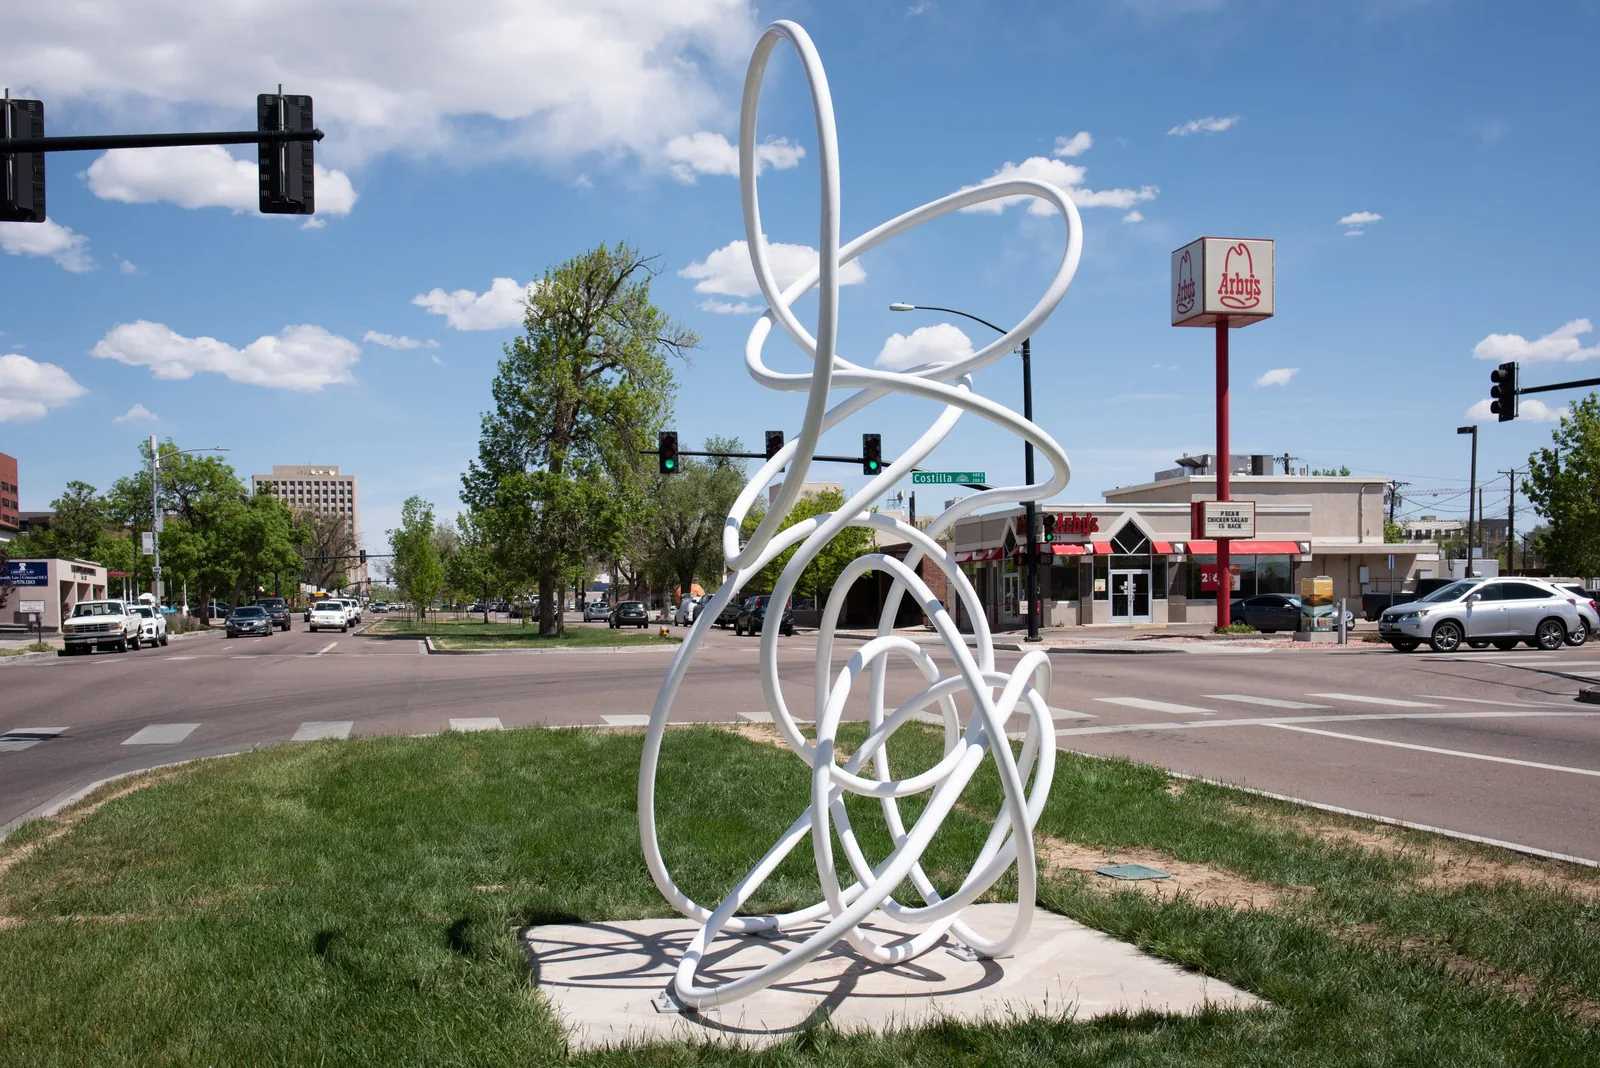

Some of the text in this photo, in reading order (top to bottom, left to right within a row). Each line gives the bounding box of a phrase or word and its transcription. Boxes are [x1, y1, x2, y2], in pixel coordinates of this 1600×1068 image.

[1176, 278, 1196, 305] Arby's
[1217, 272, 1262, 301] Arby's
[914, 473, 952, 483] Costilla
[1054, 512, 1099, 537] Arby's
[1201, 572, 1208, 582] 2
